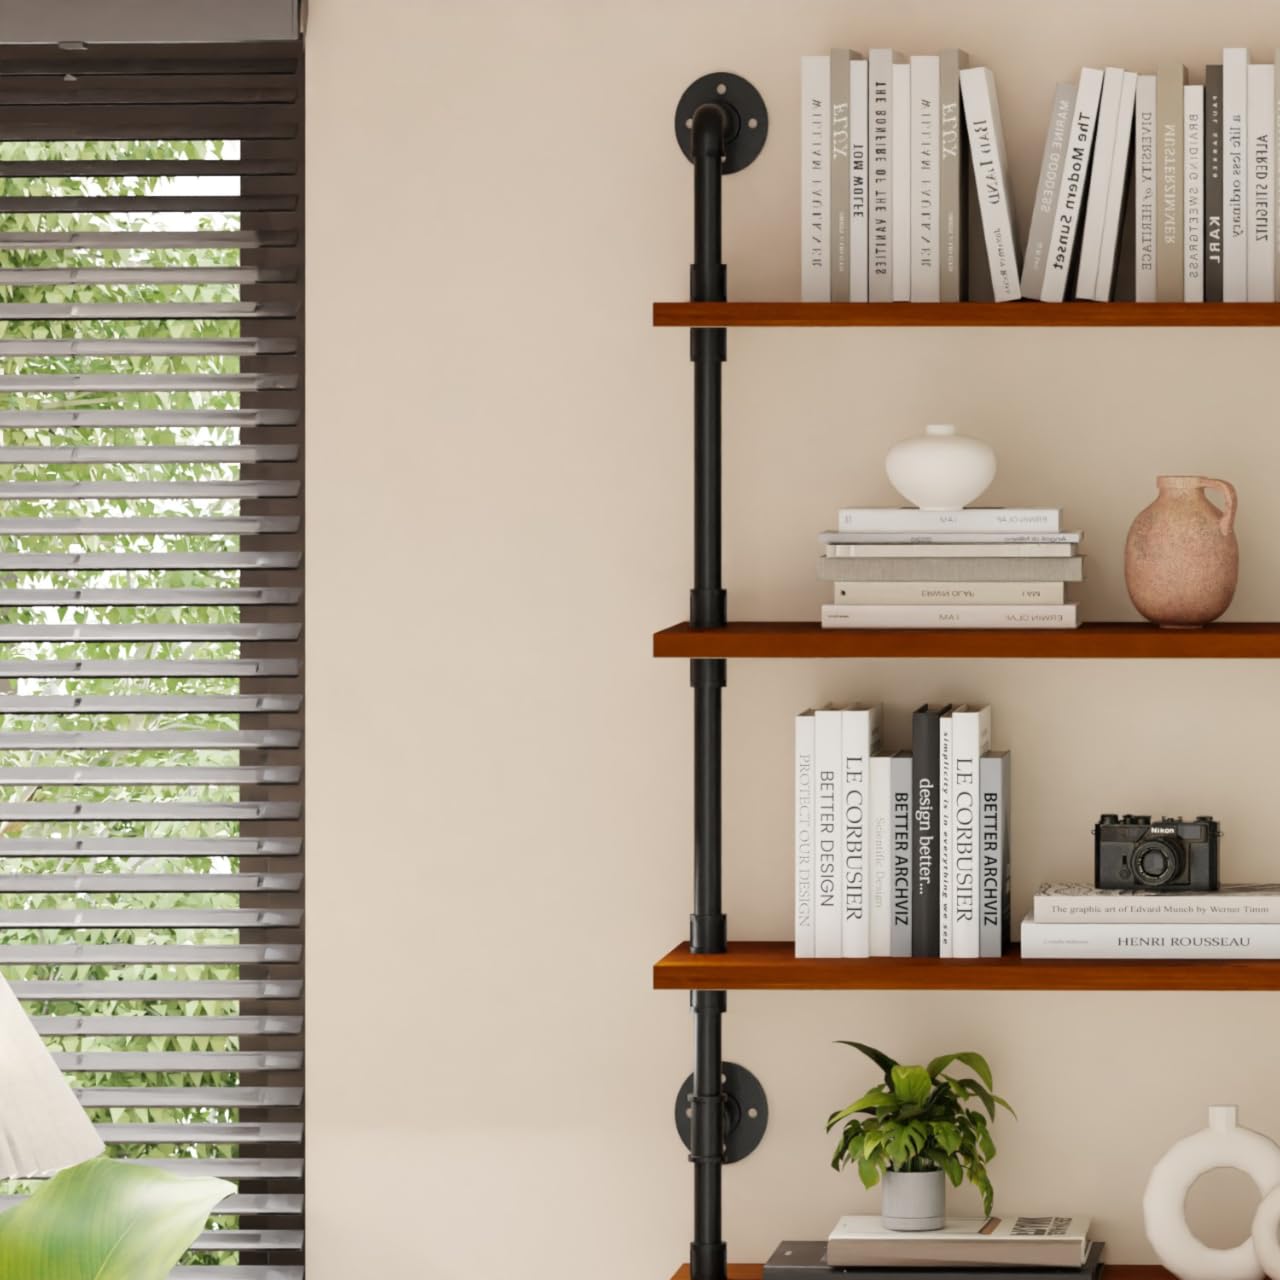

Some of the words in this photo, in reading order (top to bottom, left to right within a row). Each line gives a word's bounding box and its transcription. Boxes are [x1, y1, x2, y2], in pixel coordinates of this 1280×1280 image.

[799, 754, 810, 826] PROTECT
[846, 757, 863, 783] LE
[956, 759, 973, 784] LE
[820, 771, 834, 833] BETTER
[895, 792, 908, 850] BETTER
[915, 778, 934, 831] design
[983, 792, 998, 850] BETTER
[820, 840, 834, 907] DESIGN
[846, 790, 863, 921] CORBUSIER
[919, 836, 934, 895] better...
[956, 791, 973, 922] CORBUSIER
[799, 869, 810, 927] DESIGN
[895, 855, 908, 926] ARCHVIZ
[983, 855, 998, 926] ARCHVIZ
[1052, 905, 1068, 913] The
[1118, 905, 1128, 913] of
[1117, 937, 1166, 946] HENRI
[1170, 937, 1250, 946] ROUSSEAU
